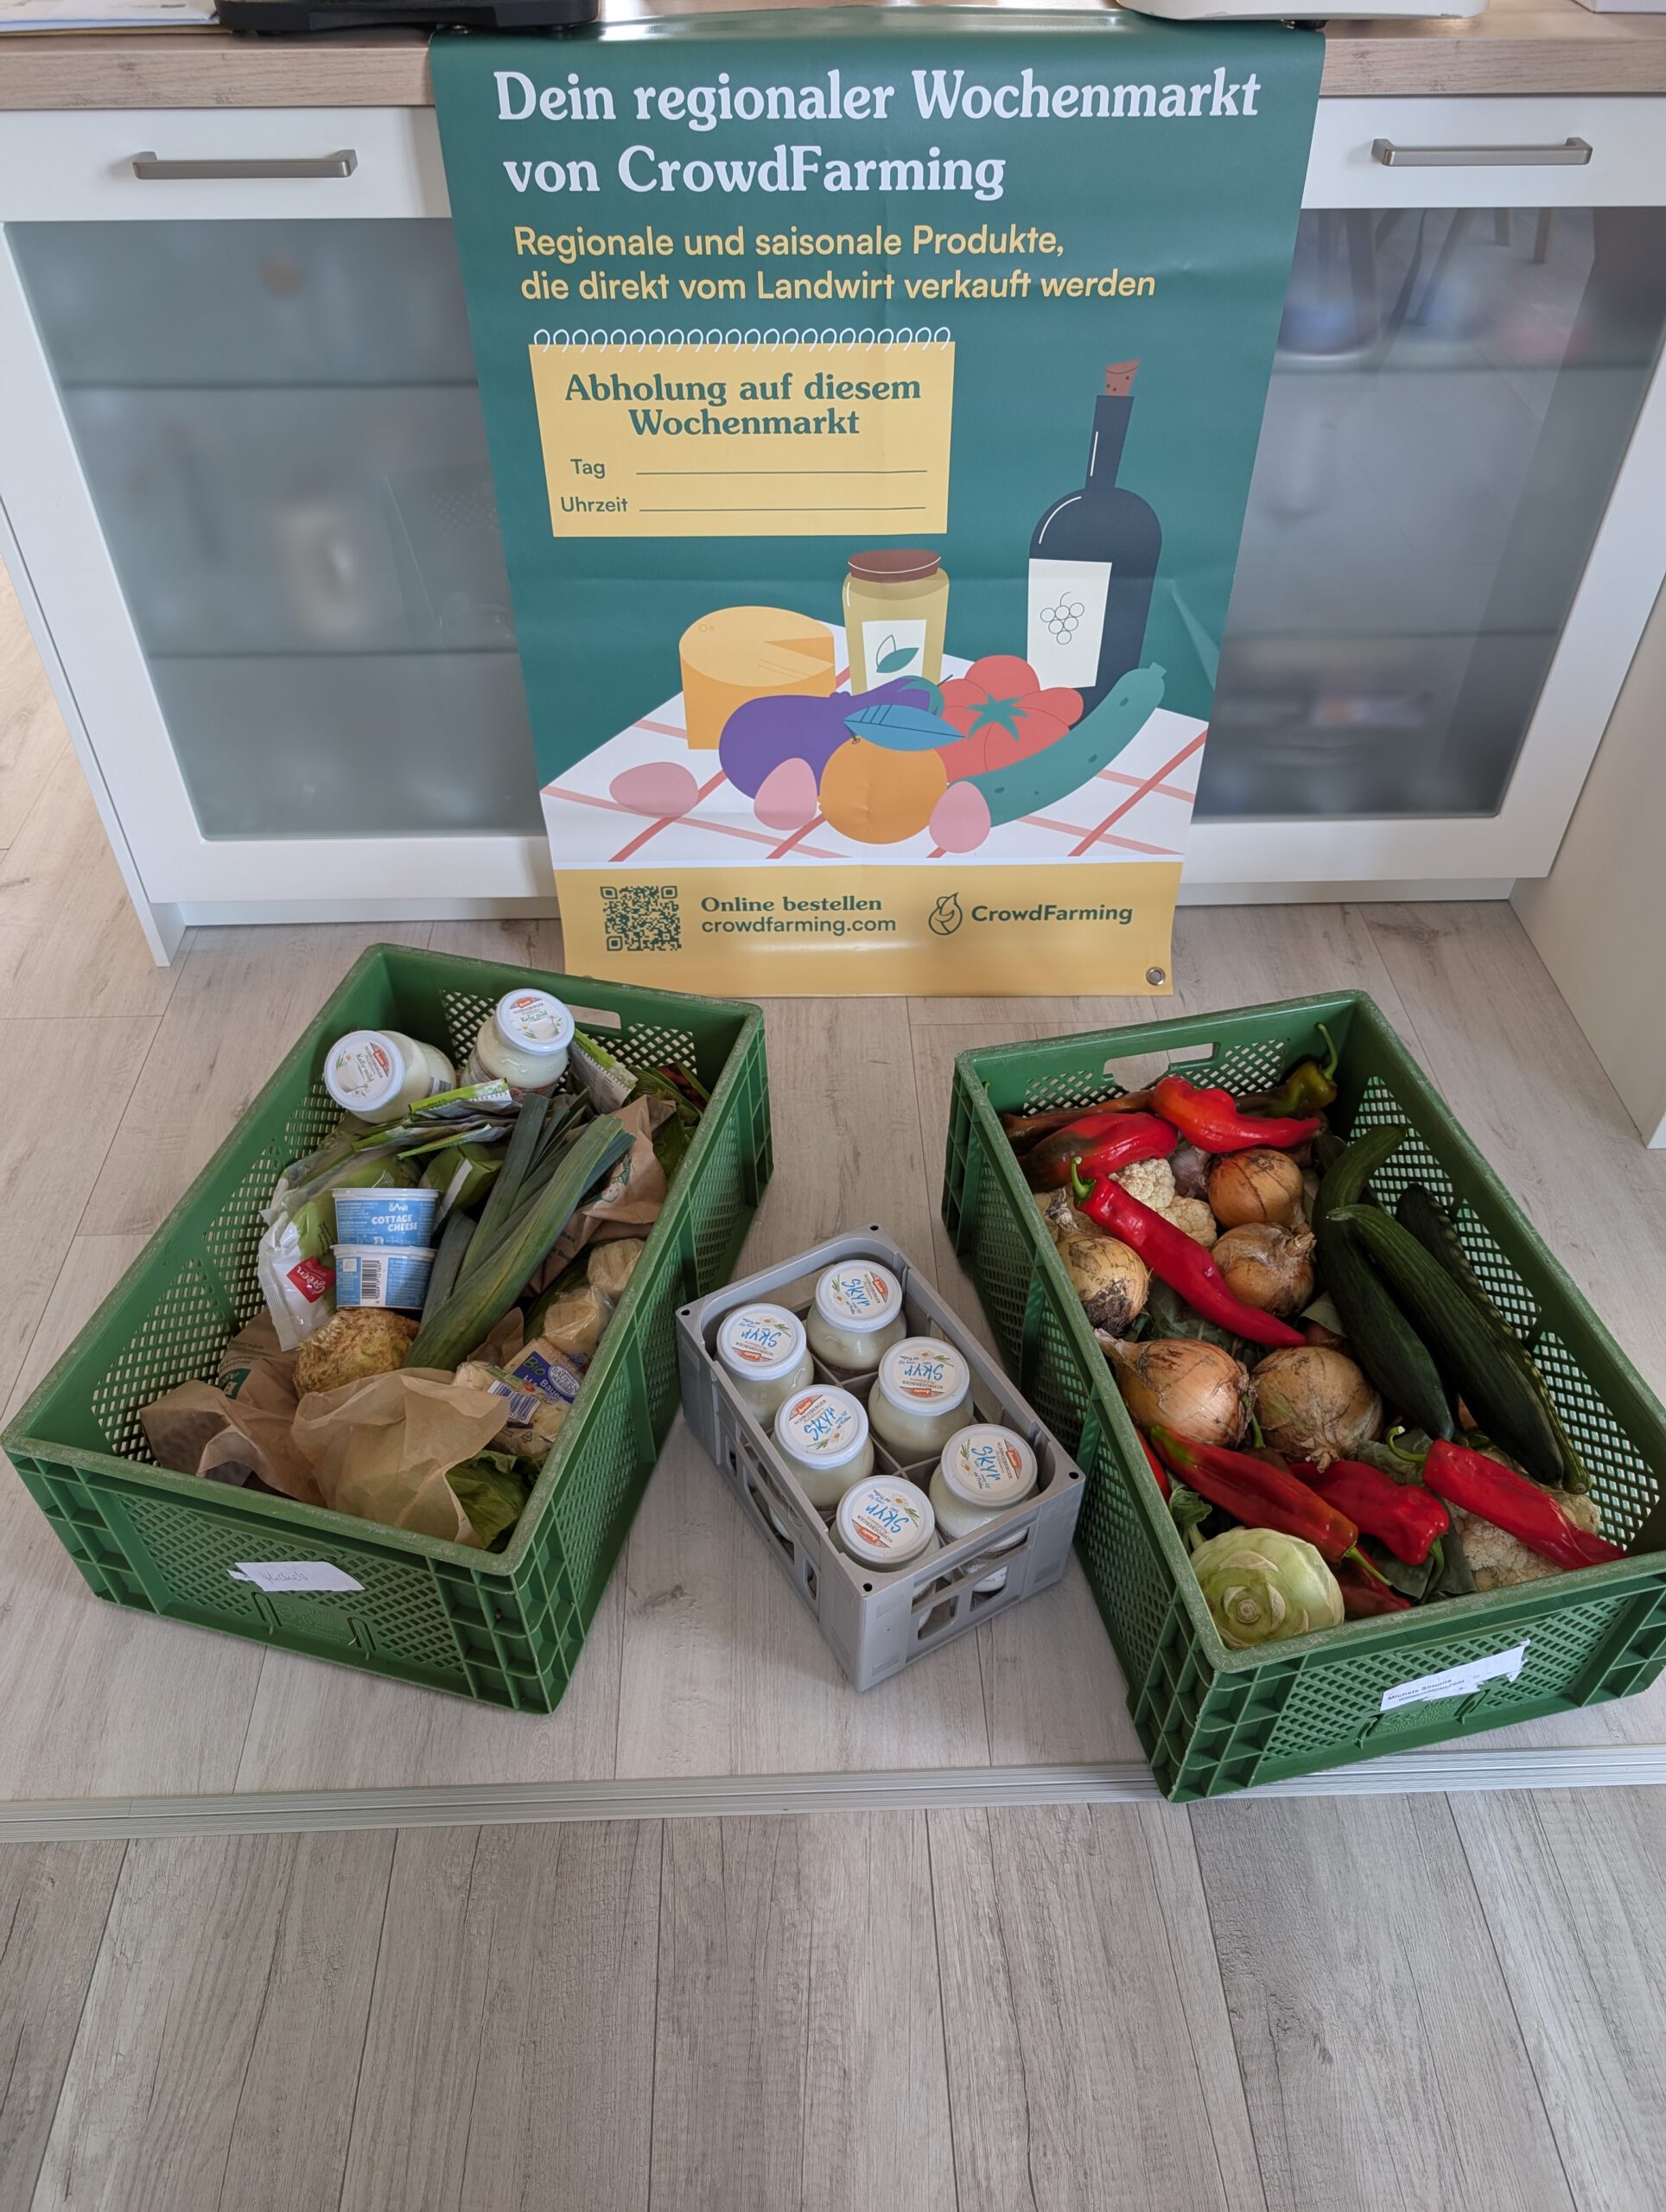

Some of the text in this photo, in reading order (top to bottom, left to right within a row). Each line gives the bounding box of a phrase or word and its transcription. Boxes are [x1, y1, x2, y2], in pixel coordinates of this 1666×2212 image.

[493, 67, 1262, 131] Dein regionaler Wochenmarkt
[503, 143, 1006, 201] von CrowdFarming
[514, 223, 1065, 264] Regionale und saisonale Produkte,
[521, 267, 1155, 300] die direkt vom Landwirt verkauft werden
[565, 372, 921, 407] Abholung auf diesem
[628, 408, 860, 436] Wochenmarkt
[569, 458, 606, 480] Tag
[560, 496, 628, 513] Uhrzeit
[700, 895, 882, 912] Online bestellen
[970, 903, 1133, 925] CrowdFarming
[701, 916, 897, 937] crowdfarming.com
[536, 1010, 549, 1019] mild
[356, 1053, 375, 1083] Kefir mild
[372, 1214, 413, 1224] COTTAGE
[387, 1223, 418, 1232] CHEESE
[296, 1266, 326, 1294] Green
[1421, 1679, 1453, 1690] Simone
